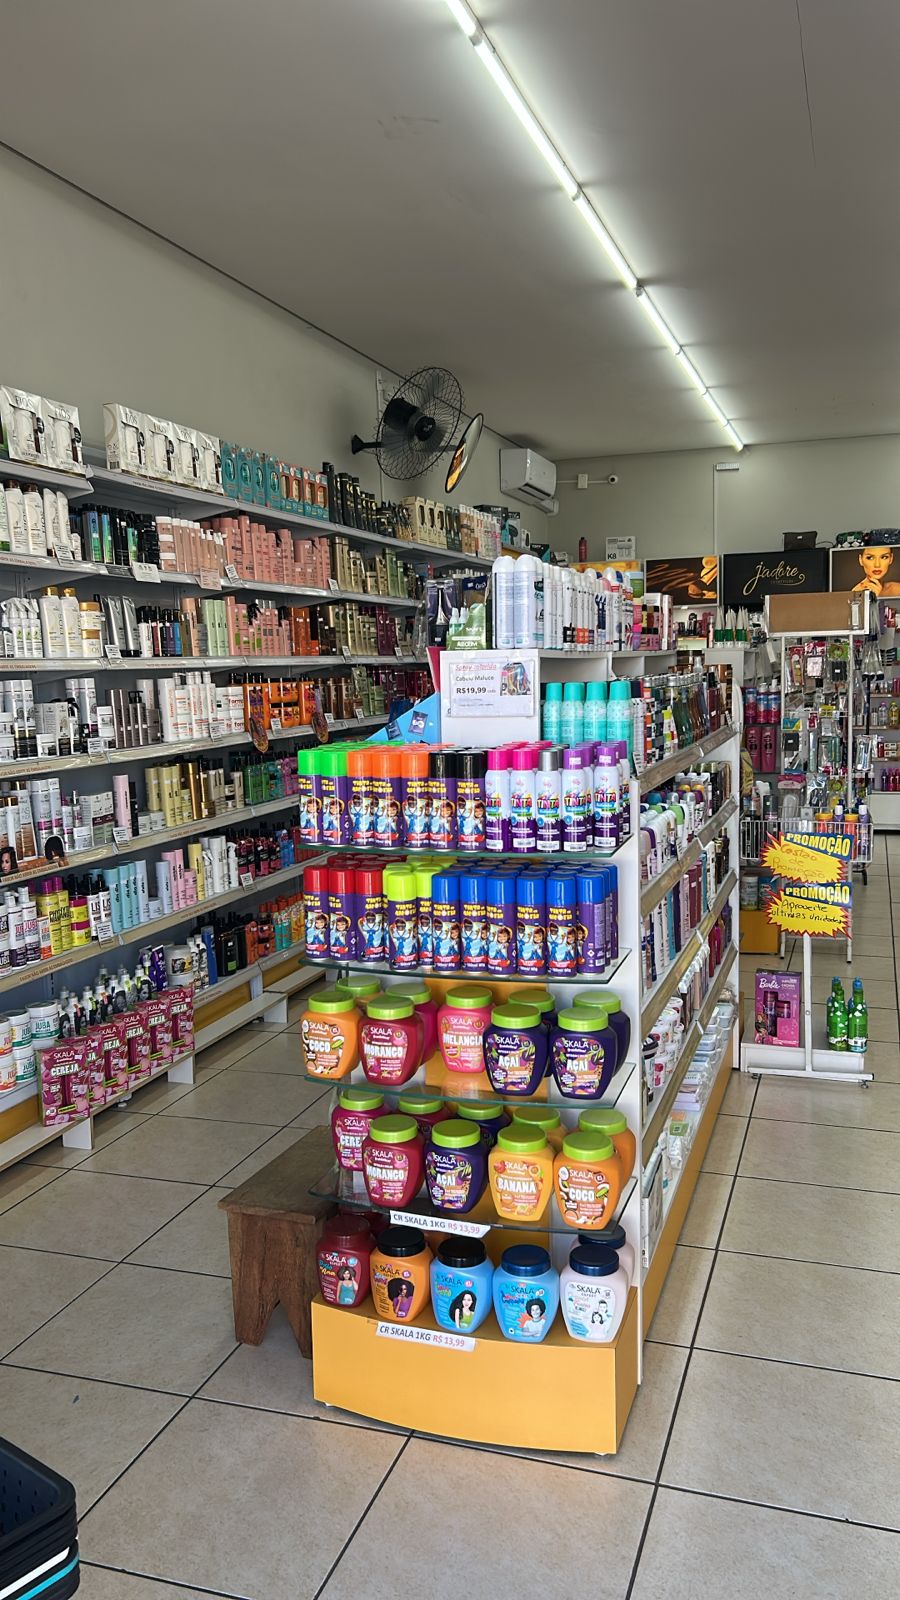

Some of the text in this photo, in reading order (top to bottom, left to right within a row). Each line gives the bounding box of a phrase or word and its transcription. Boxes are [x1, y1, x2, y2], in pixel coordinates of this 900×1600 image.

[456, 687, 486, 695] R$19,99
[537, 798, 560, 808] TINTA
[564, 796, 586, 808] TINTA
[595, 792, 617, 804] TINTA
[786, 832, 851, 857] PROMOÇÃO
[785, 882, 850, 905] PROMOÇÃO
[760, 978, 780, 989] Barbie
[36, 1020, 50, 1030] JUBA
[309, 1022, 330, 1033] SKALA
[450, 1017, 473, 1026] SKALA
[370, 1026, 392, 1036] SKALA
[443, 1034, 483, 1046] MELANCIA
[496, 1036, 520, 1046] SKALA
[564, 1040, 589, 1049] SKALA
[309, 1040, 332, 1053] COCO
[364, 1043, 404, 1058] MORANGO
[54, 1050, 75, 1060] SKALA
[498, 1055, 520, 1069] AÇAÍ
[566, 1060, 588, 1073] AÇAÍ
[51, 1064, 79, 1077] CEREJA
[344, 1119, 366, 1128] SKALA
[372, 1148, 394, 1160] SKALA
[434, 1154, 456, 1166] SKALA
[504, 1161, 528, 1171] SKALA
[367, 1165, 404, 1181] MORANGO
[569, 1170, 594, 1180] SKALA
[436, 1172, 456, 1187] AÇAÍ
[497, 1178, 537, 1194] BANANA
[568, 1188, 596, 1202] COCO
[393, 1213, 480, 1235] CR SKALA 1KG R$ 13,99
[325, 1254, 347, 1264] SKALA
[379, 1264, 400, 1276] SKALA
[441, 1276, 462, 1286] SKALA
[511, 1286, 534, 1296] SKALA
[576, 1284, 601, 1296] SKALA
[379, 1325, 465, 1348] CR SKALA 1KG R$ 13,99
